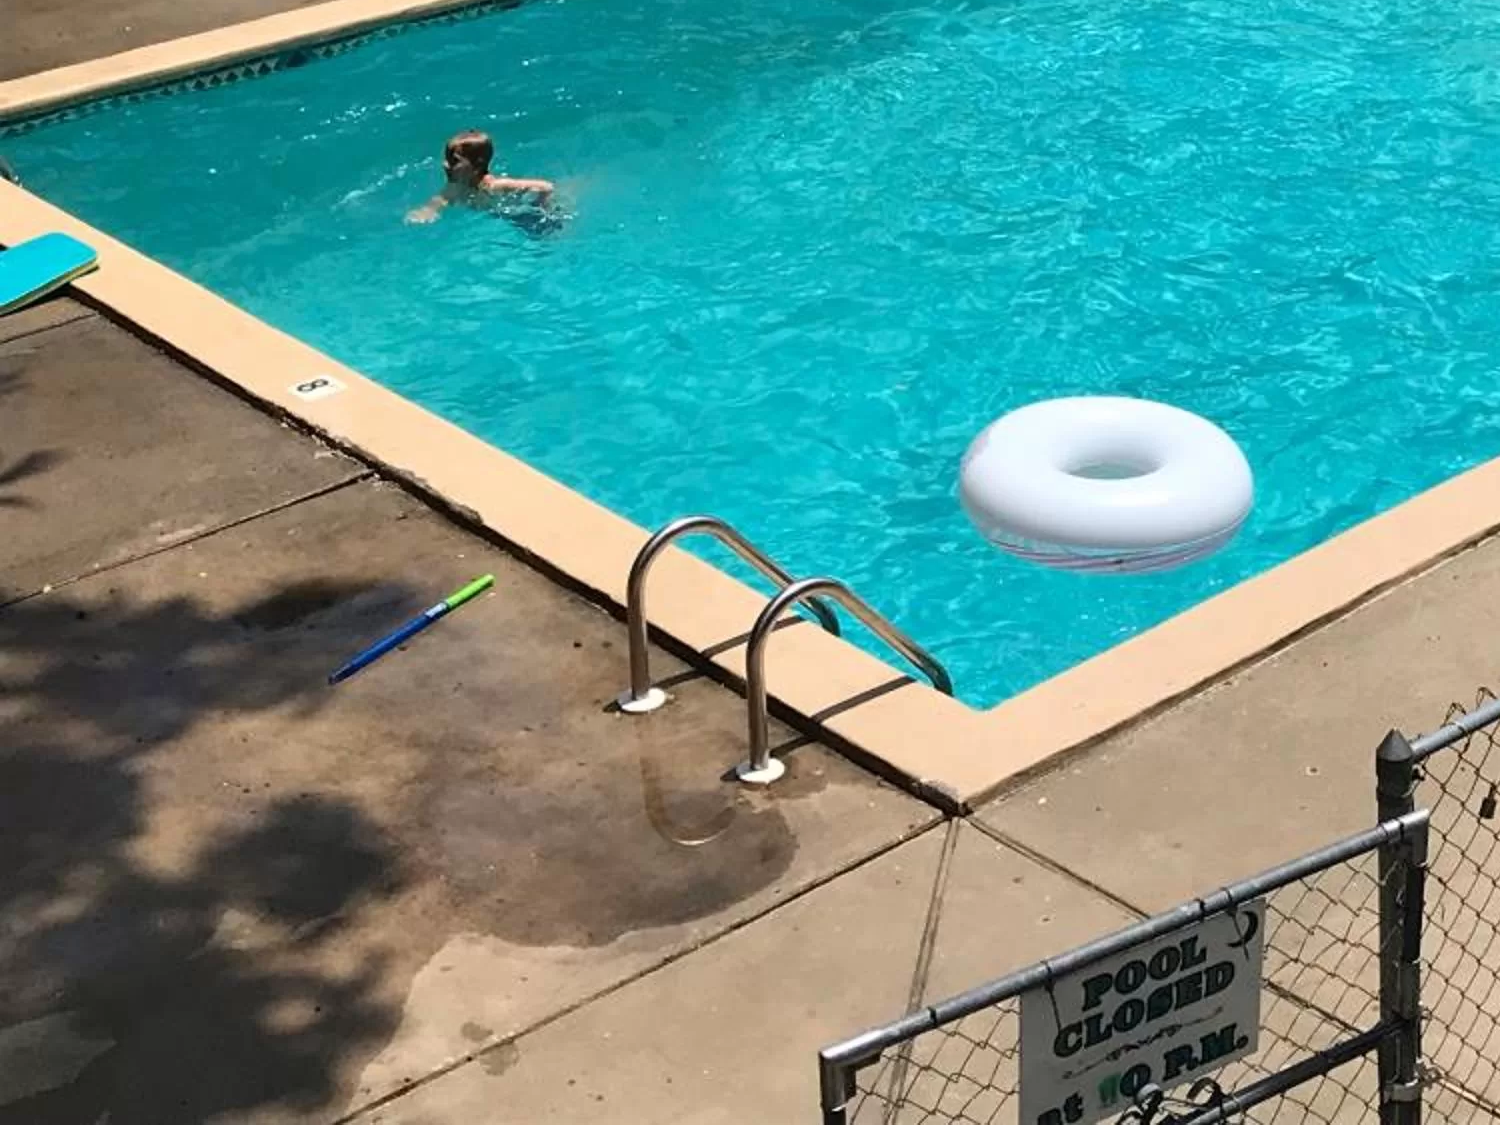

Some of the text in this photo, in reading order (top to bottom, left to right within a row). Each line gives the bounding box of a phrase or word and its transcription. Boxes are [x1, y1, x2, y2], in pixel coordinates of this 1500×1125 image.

[296, 378, 329, 393] 8
[1081, 934, 1208, 1012] POOL
[1053, 960, 1236, 1058] CLOSED
[1162, 1023, 1250, 1082] P.M.
